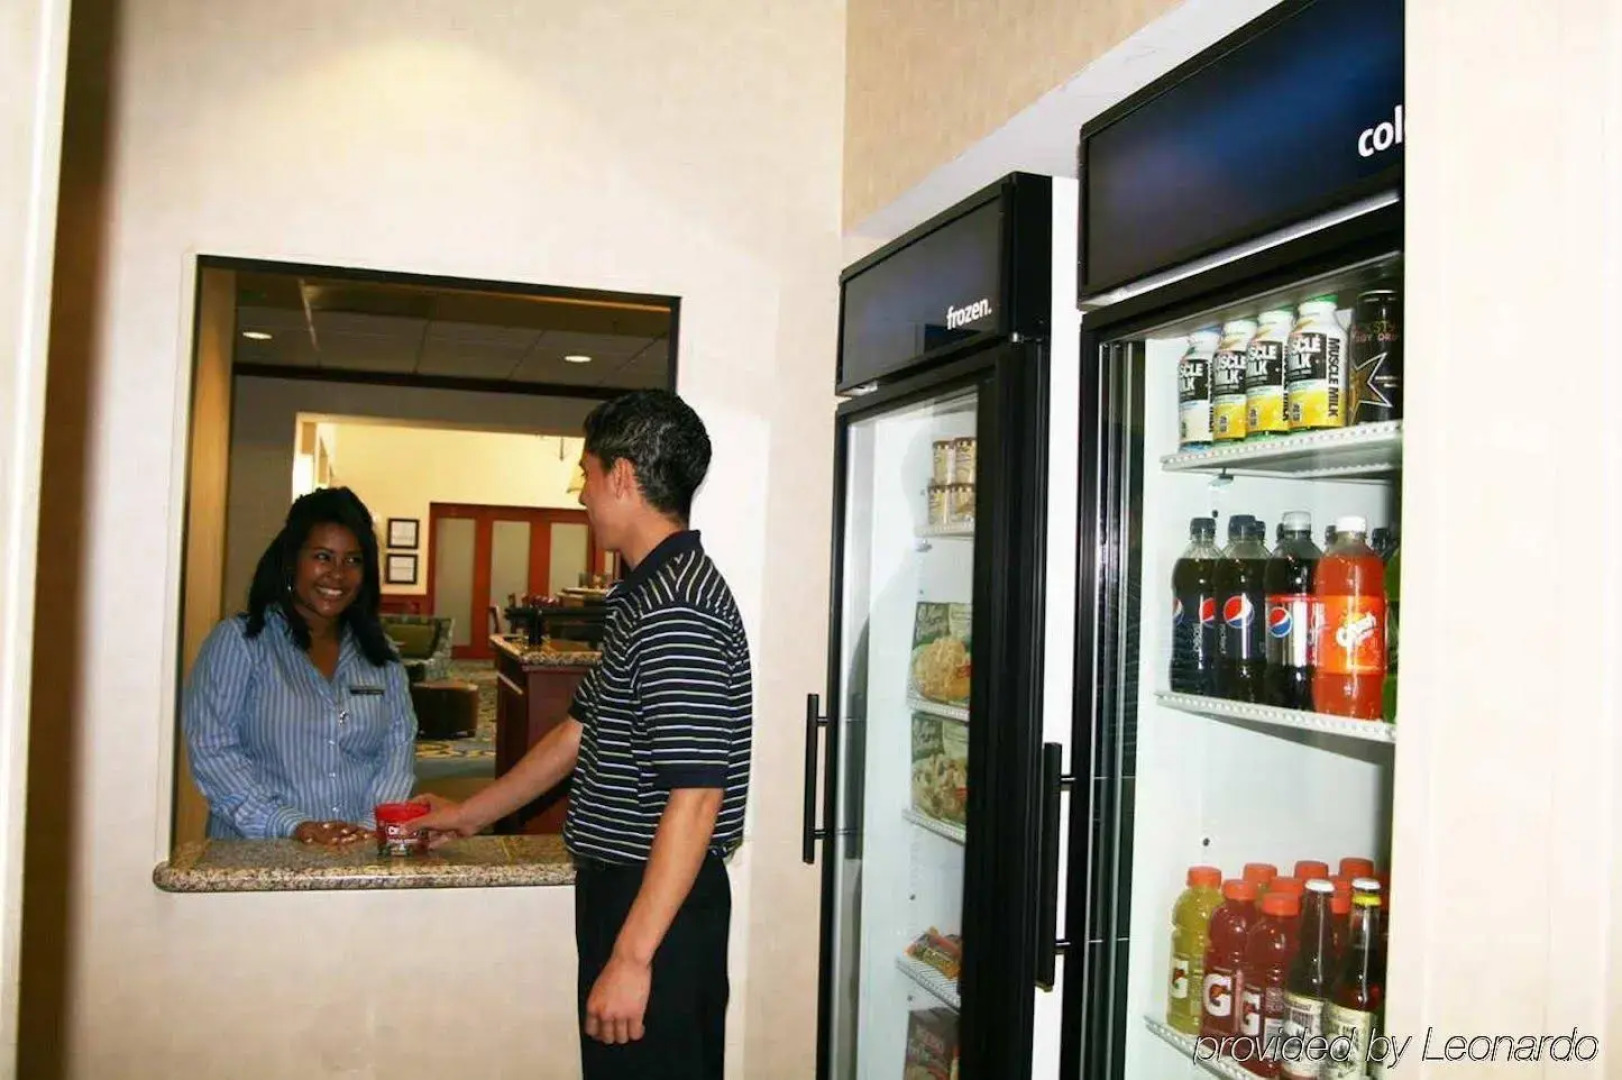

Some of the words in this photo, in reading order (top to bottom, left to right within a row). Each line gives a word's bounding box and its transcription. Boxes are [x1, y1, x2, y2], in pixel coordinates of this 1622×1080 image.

[1358, 104, 1402, 157] col
[946, 298, 992, 330] frozen.
[1328, 337, 1340, 385] MUSCLE
[1328, 387, 1340, 417] MILK
[1203, 973, 1232, 1017] G
